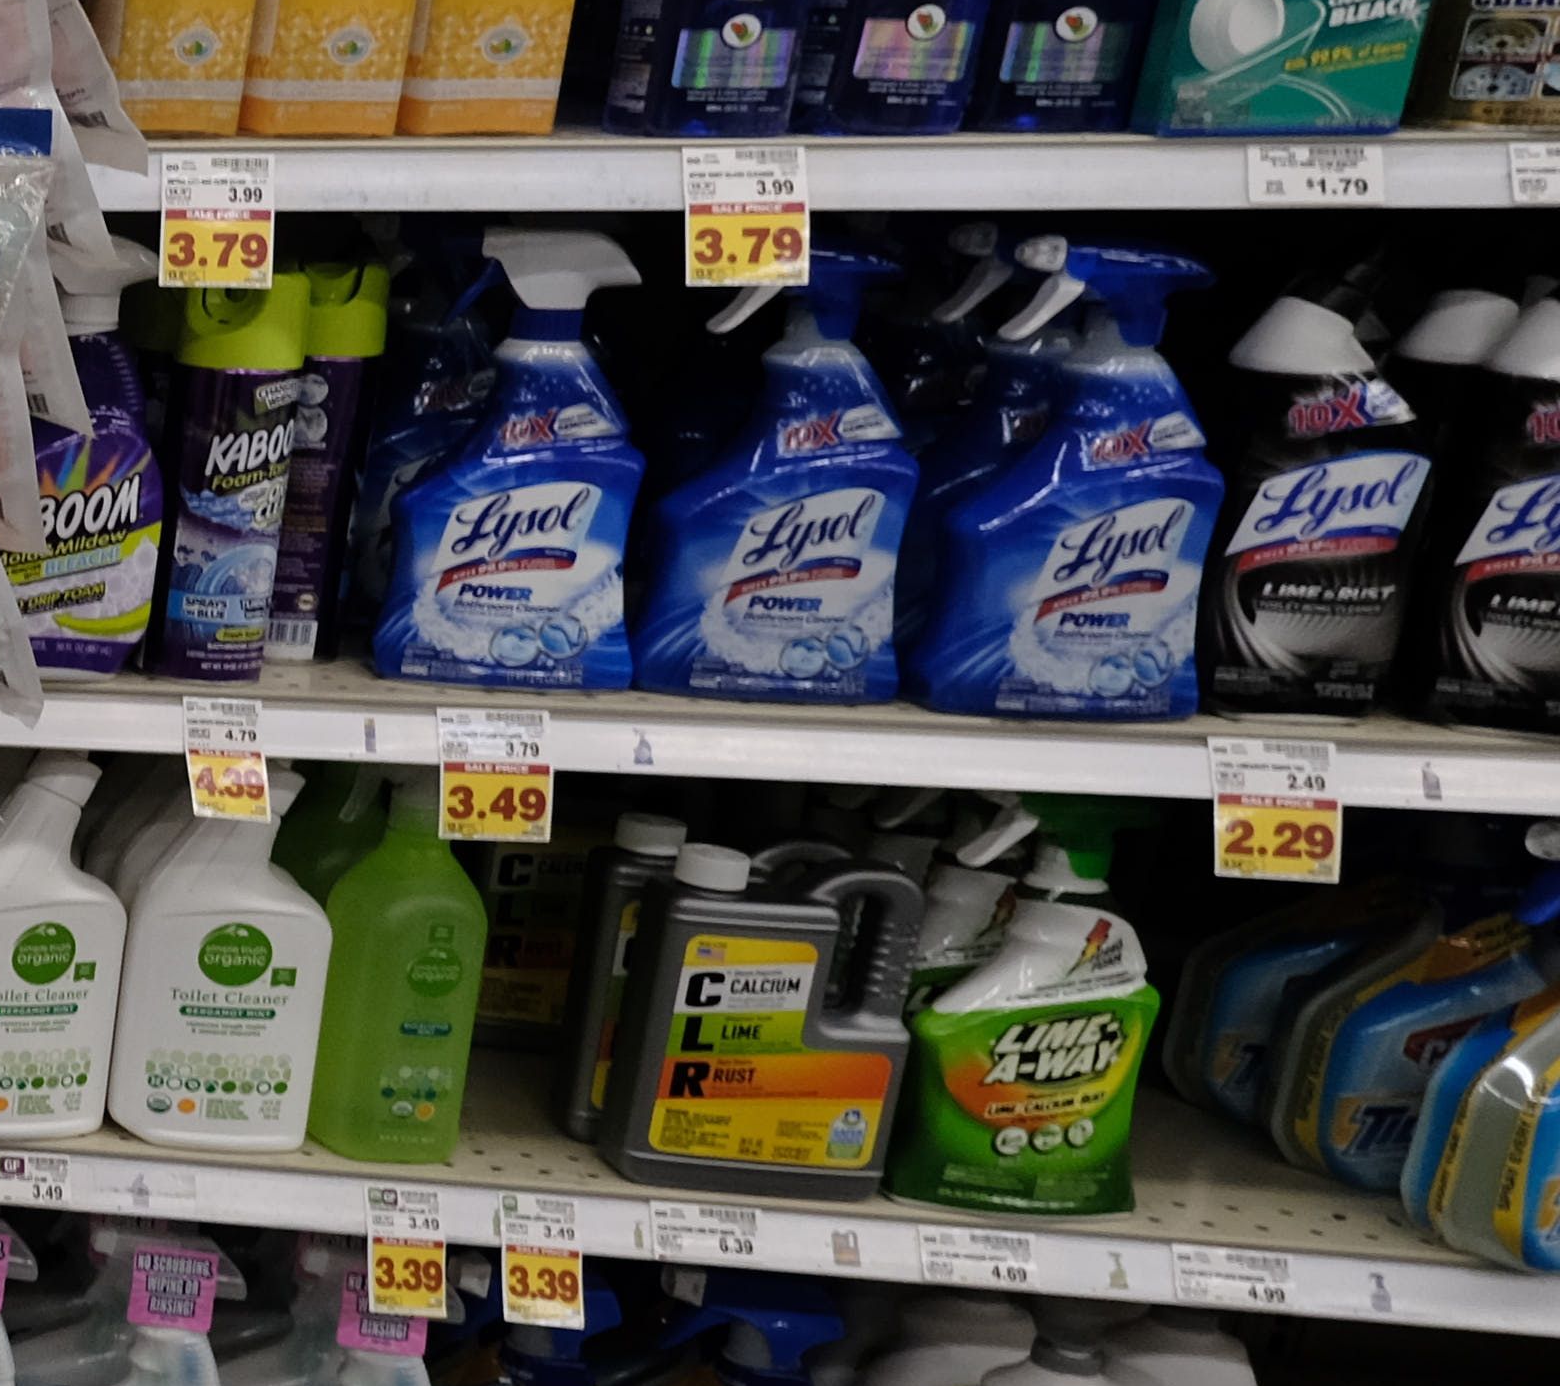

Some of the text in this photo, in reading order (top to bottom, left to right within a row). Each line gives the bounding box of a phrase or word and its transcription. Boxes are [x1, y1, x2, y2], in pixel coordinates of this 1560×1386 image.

[1306, 178, 1368, 195] $1.79
[167, 233, 269, 269] 3.79
[694, 226, 803, 265] 3.79
[453, 487, 591, 554] Lysol
[458, 583, 532, 603] POWER
[748, 594, 822, 612] POWER
[1287, 774, 1326, 792] 2.49
[447, 786, 548, 824] 3.49
[1223, 820, 1335, 861] 2.29
[17, 951, 71, 969] organic
[36, 985, 89, 1003] Cleaner
[685, 972, 725, 1007] C
[730, 978, 800, 995] CALCIUM
[681, 1016, 714, 1053] L
[722, 1024, 762, 1040] LIME
[669, 1062, 711, 1098] R
[712, 1067, 756, 1085] RUST
[376, 1257, 443, 1291] 3.39
[508, 1266, 579, 1301] 3.39
